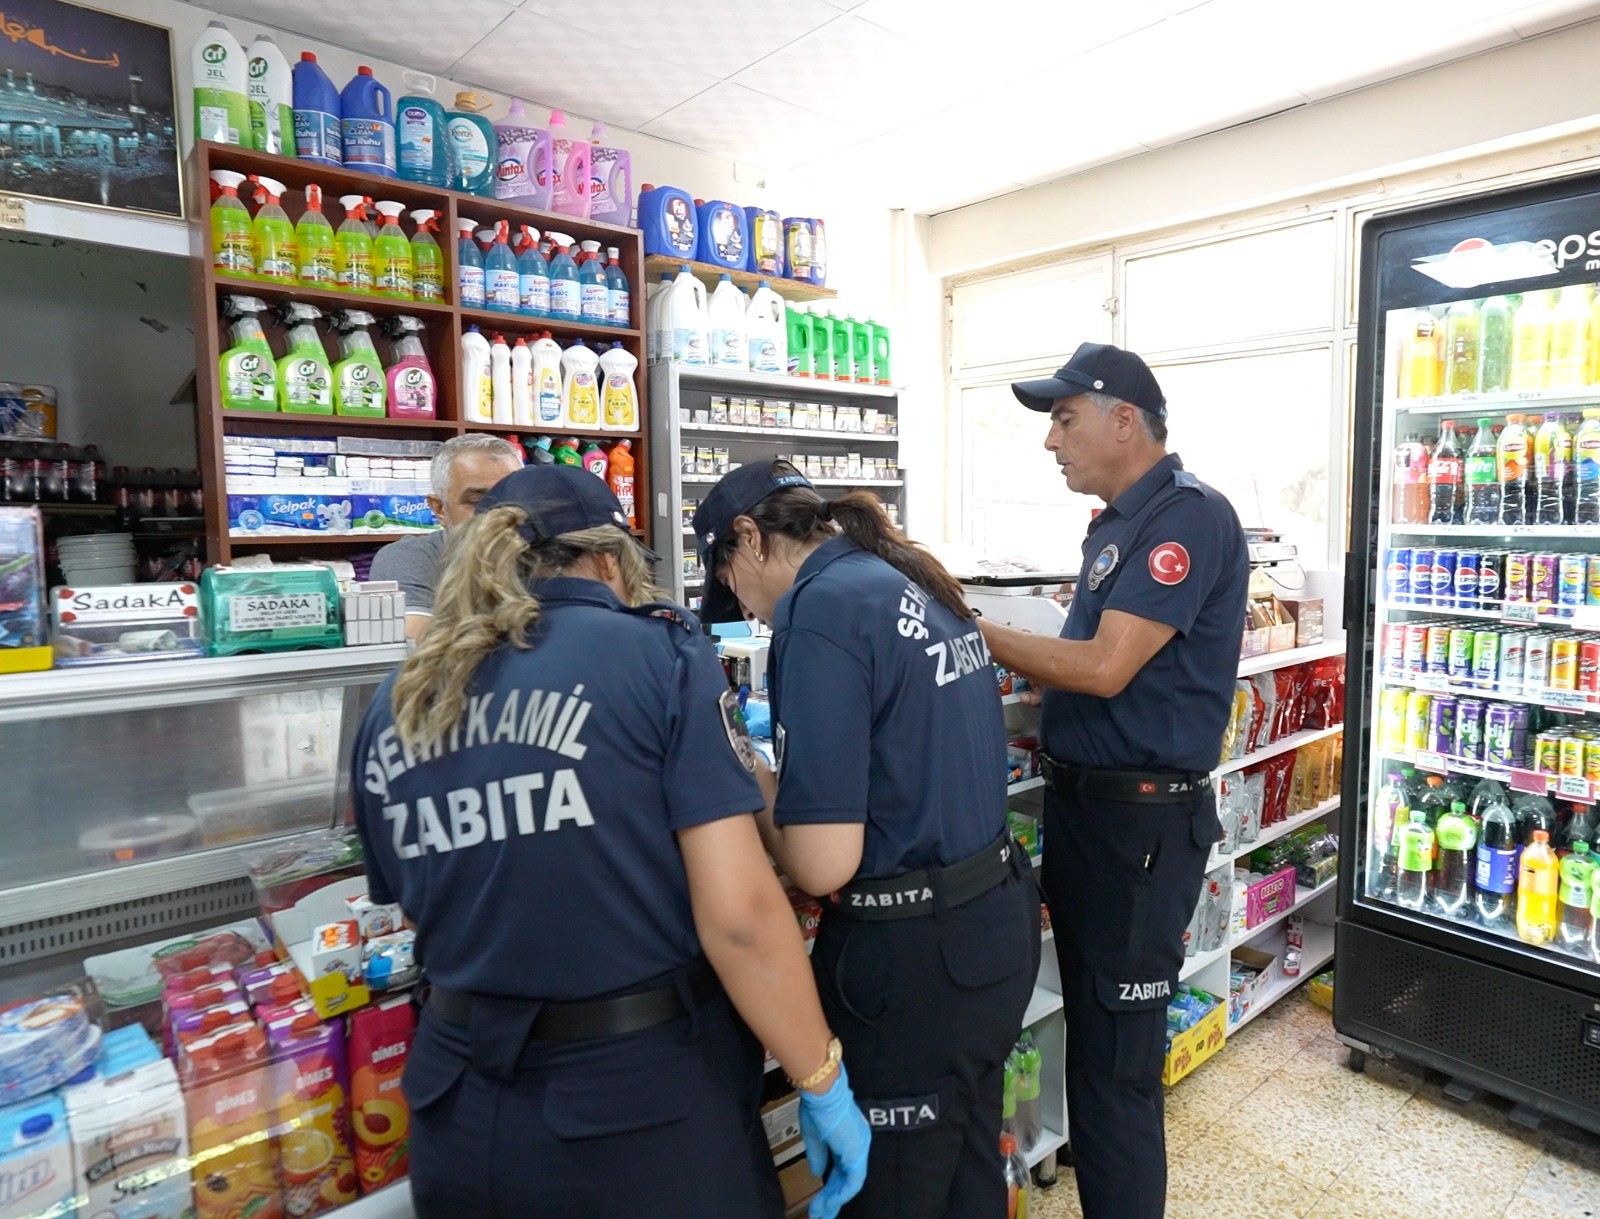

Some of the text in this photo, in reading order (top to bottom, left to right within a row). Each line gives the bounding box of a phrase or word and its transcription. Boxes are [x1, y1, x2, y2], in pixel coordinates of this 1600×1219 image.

[204, 45, 224, 61] Cif
[207, 68, 226, 78] JEL
[250, 58, 266, 76] Cif
[250, 84, 267, 94] JEL
[357, 137, 382, 146] Ruhu
[241, 356, 259, 371] Cif
[299, 361, 317, 377] Cif
[352, 366, 369, 381] Cif
[406, 371, 422, 384] Cif
[270, 498, 316, 515] Selpak
[73, 589, 185, 611] SadakA
[247, 598, 311, 612] SADAKA
[924, 630, 992, 688] ZABITA
[364, 683, 593, 805] ŞEHKAMİL
[381, 768, 595, 860] ZABITA
[851, 886, 934, 907] ZABITA
[1261, 878, 1285, 899] BEBETO
[1119, 980, 1171, 1001] ZABITA
[372, 1041, 407, 1064] DİMES
[868, 1104, 937, 1126] BITA
